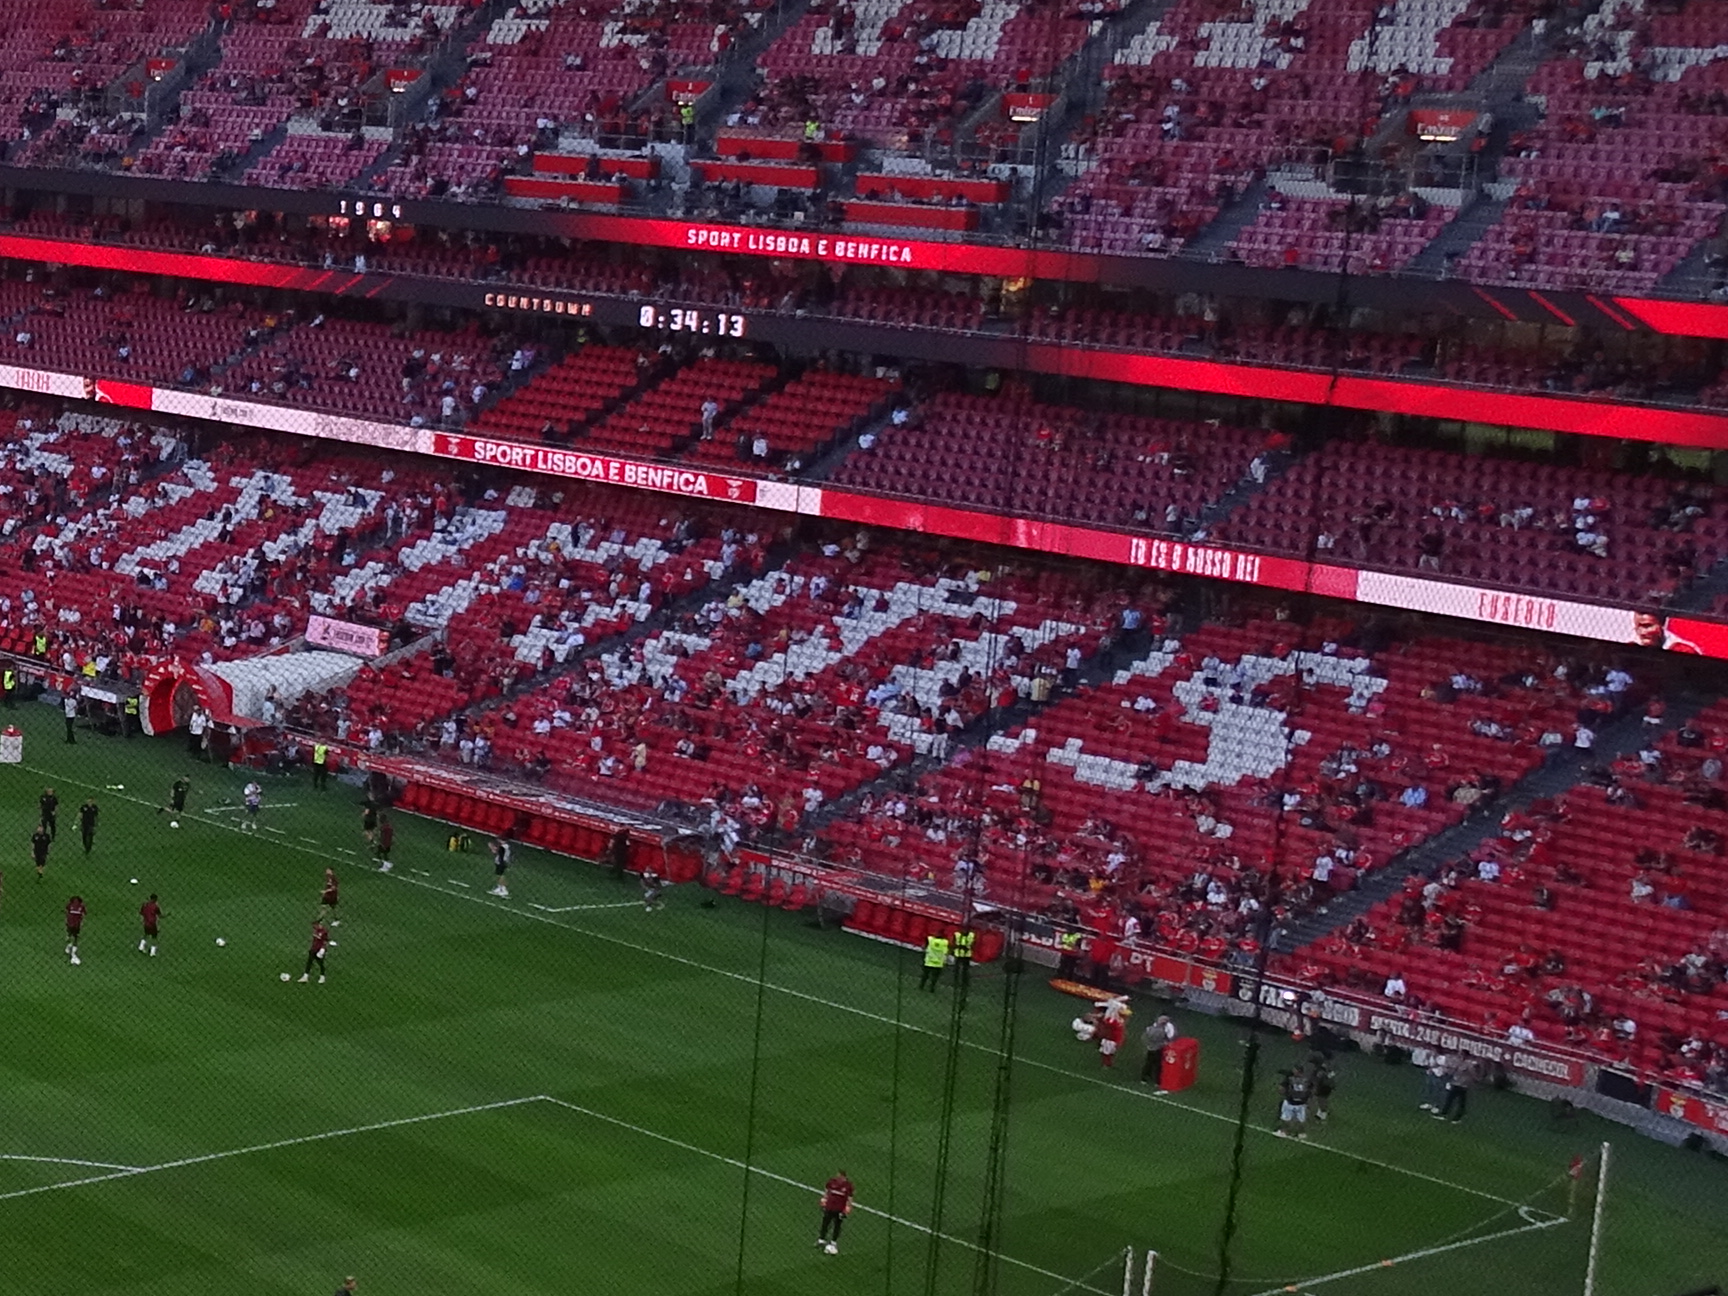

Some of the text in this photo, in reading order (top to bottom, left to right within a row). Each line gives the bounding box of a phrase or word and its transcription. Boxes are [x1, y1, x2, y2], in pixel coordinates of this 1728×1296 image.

[687, 228, 912, 263] SPORT LISBOA E BENFICA
[484, 292, 745, 338] COUNTDOWN 0:34:13
[473, 439, 709, 495] SPORT LISBOA E BENFICA
